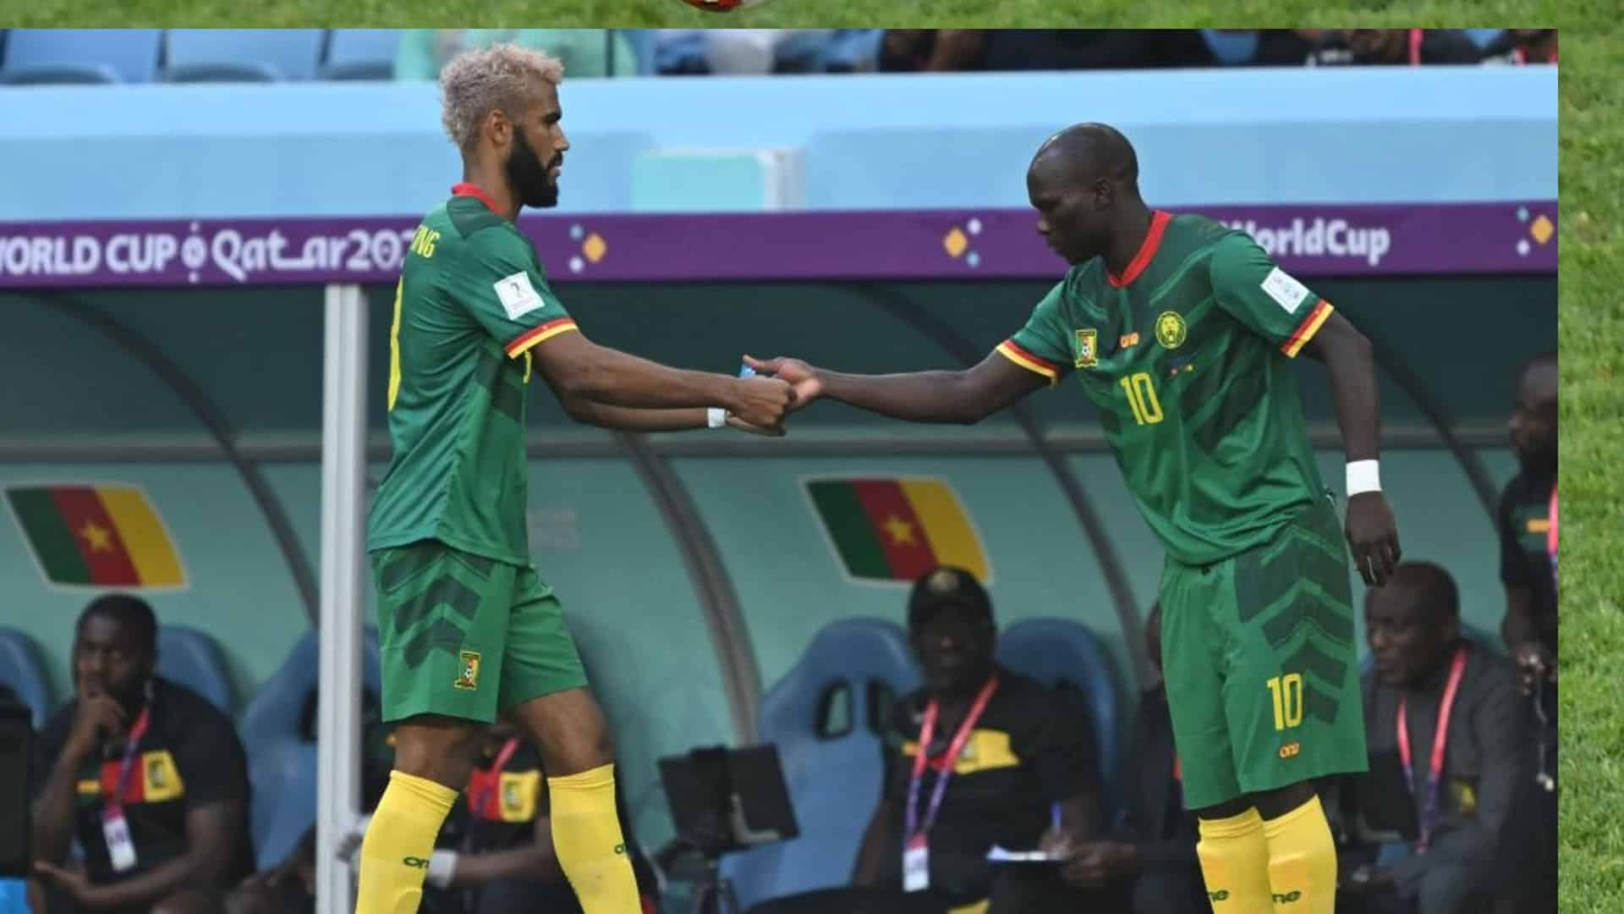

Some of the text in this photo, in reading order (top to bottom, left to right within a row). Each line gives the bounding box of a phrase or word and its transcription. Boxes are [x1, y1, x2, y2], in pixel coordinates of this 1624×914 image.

[0, 235, 101, 275] ORLD
[105, 233, 179, 273] CUP
[1120, 371, 1164, 426] 10
[1266, 672, 1303, 731] 10
[403, 856, 430, 870] on
[1272, 889, 1302, 904] ne
